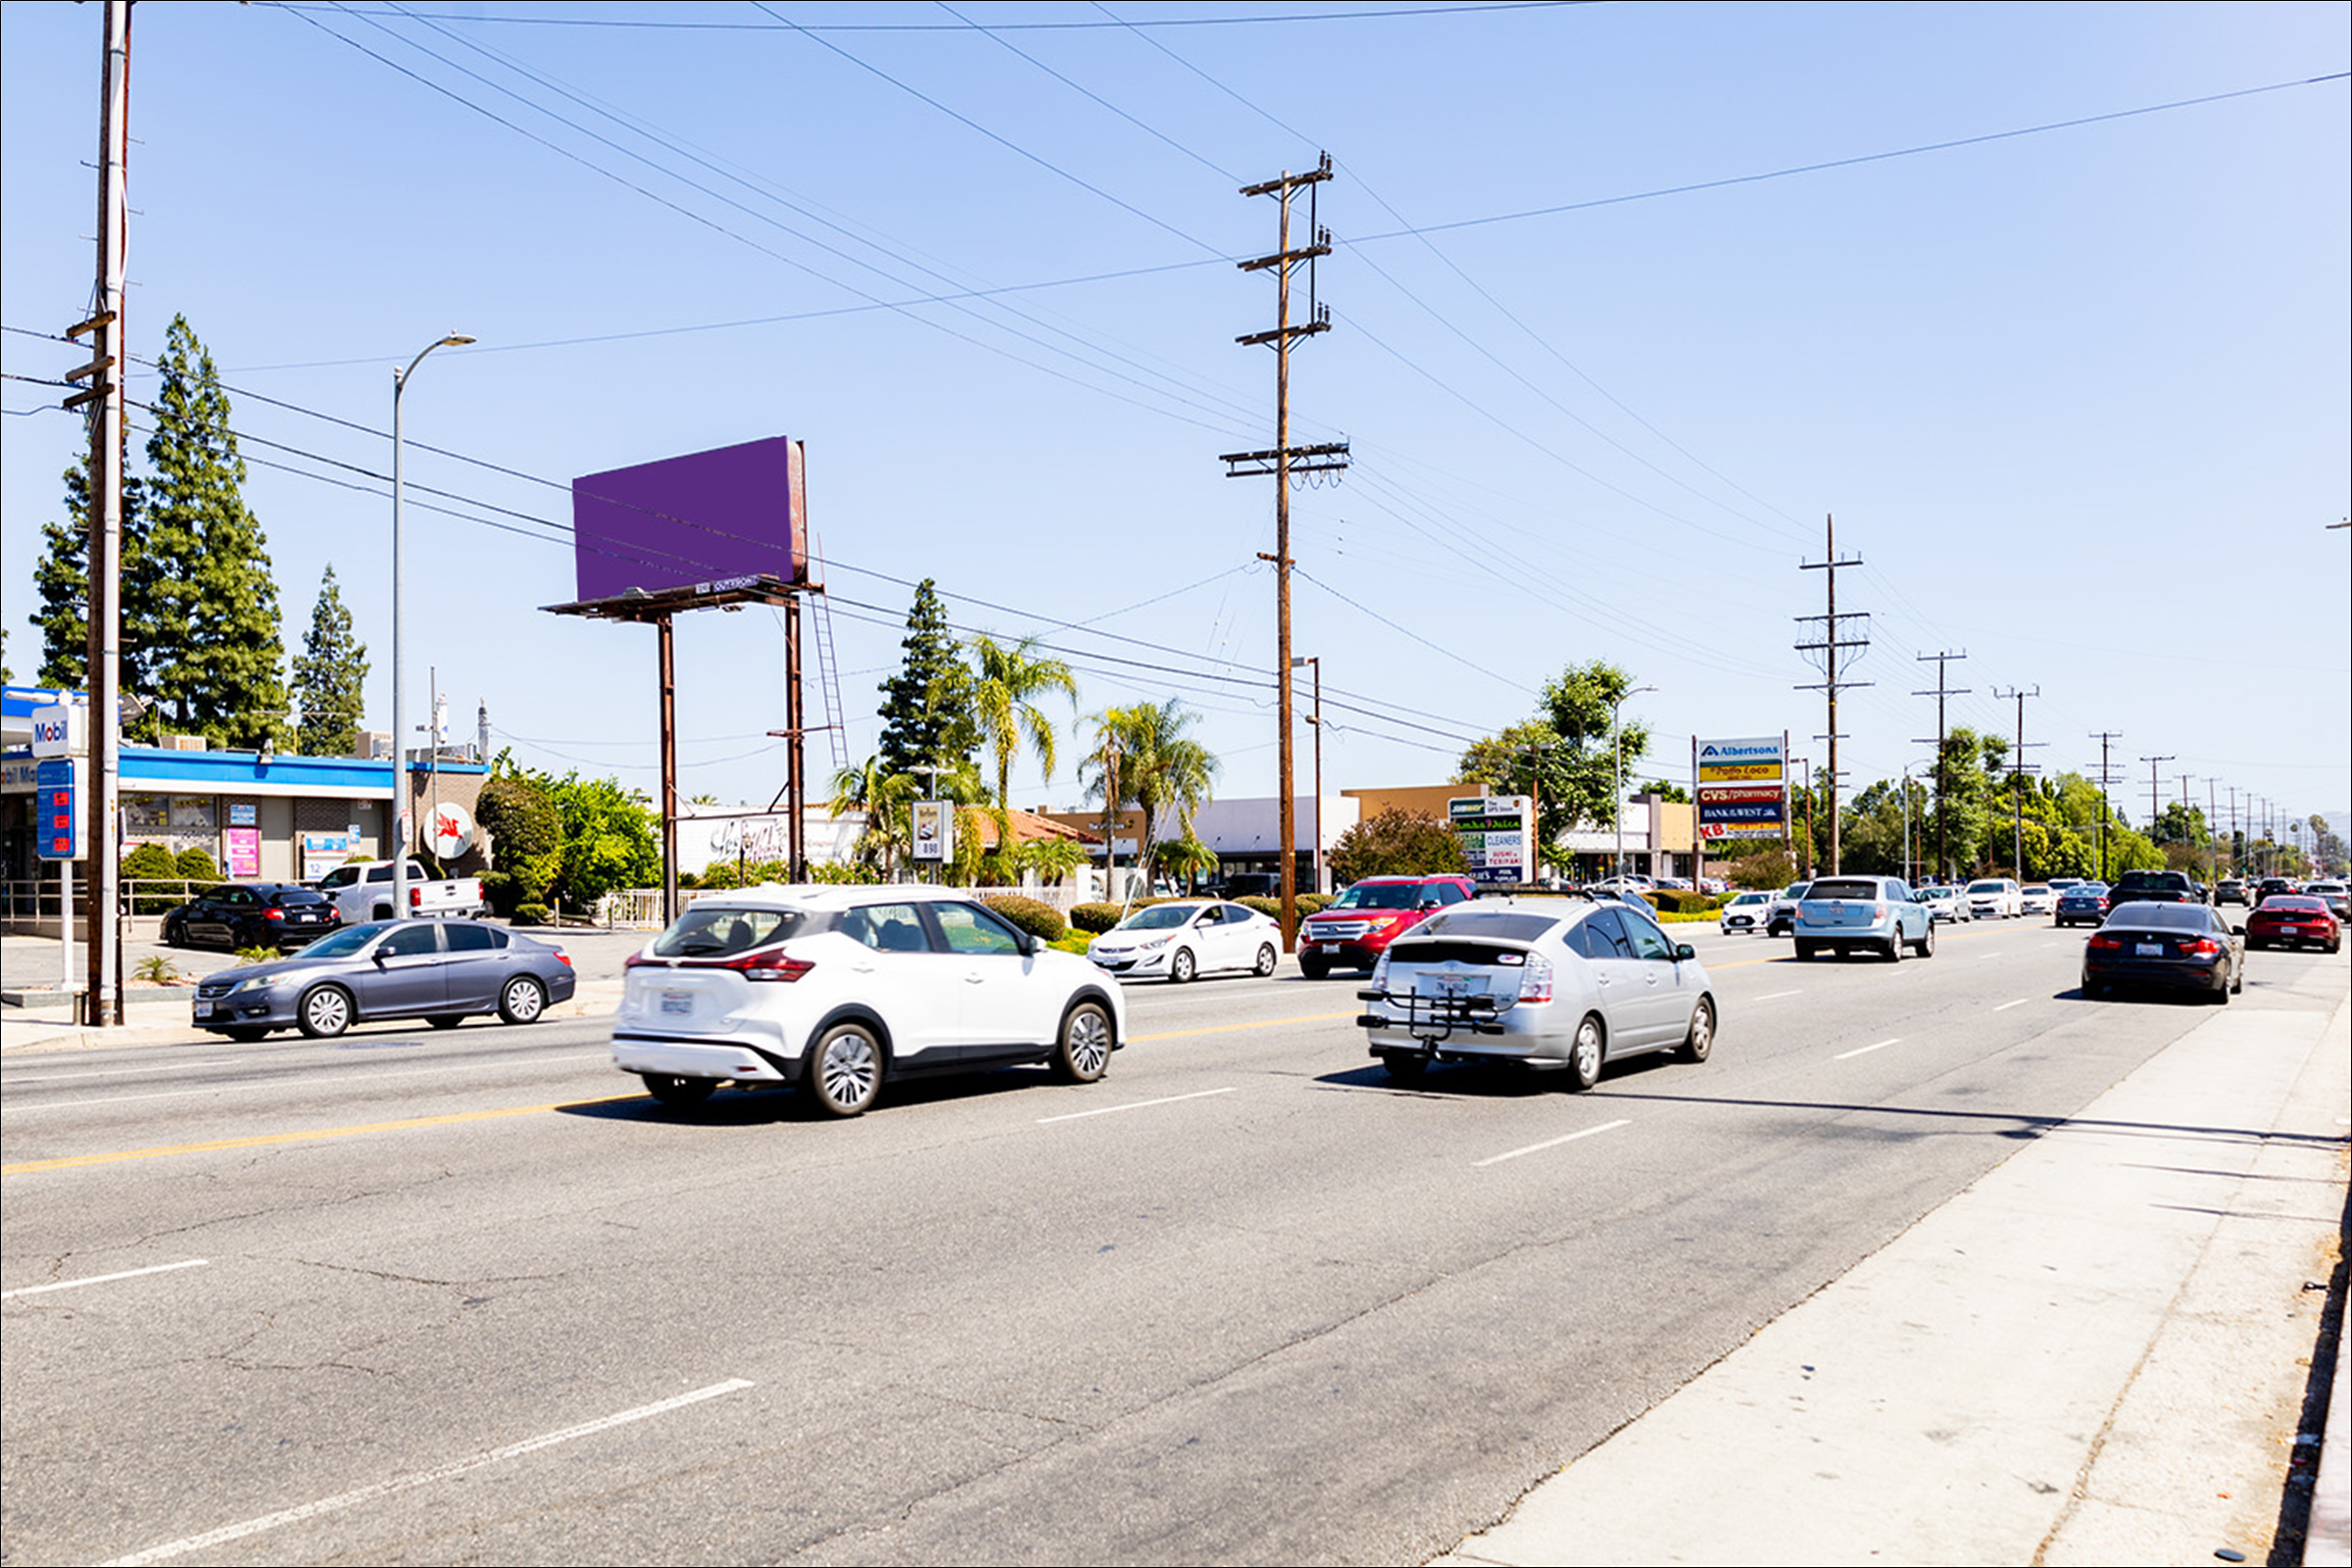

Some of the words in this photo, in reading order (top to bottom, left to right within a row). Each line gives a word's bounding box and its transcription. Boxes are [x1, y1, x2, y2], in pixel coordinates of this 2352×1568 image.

[34, 720, 68, 743] Mobil
[1721, 746, 1779, 756] Albertsons
[1744, 765, 1770, 775] Loco
[1700, 790, 1780, 802] CVS/pharmacy
[1492, 819, 1520, 828] Juice
[1699, 822, 1725, 839] KB
[1487, 835, 1522, 846] CLEANERS
